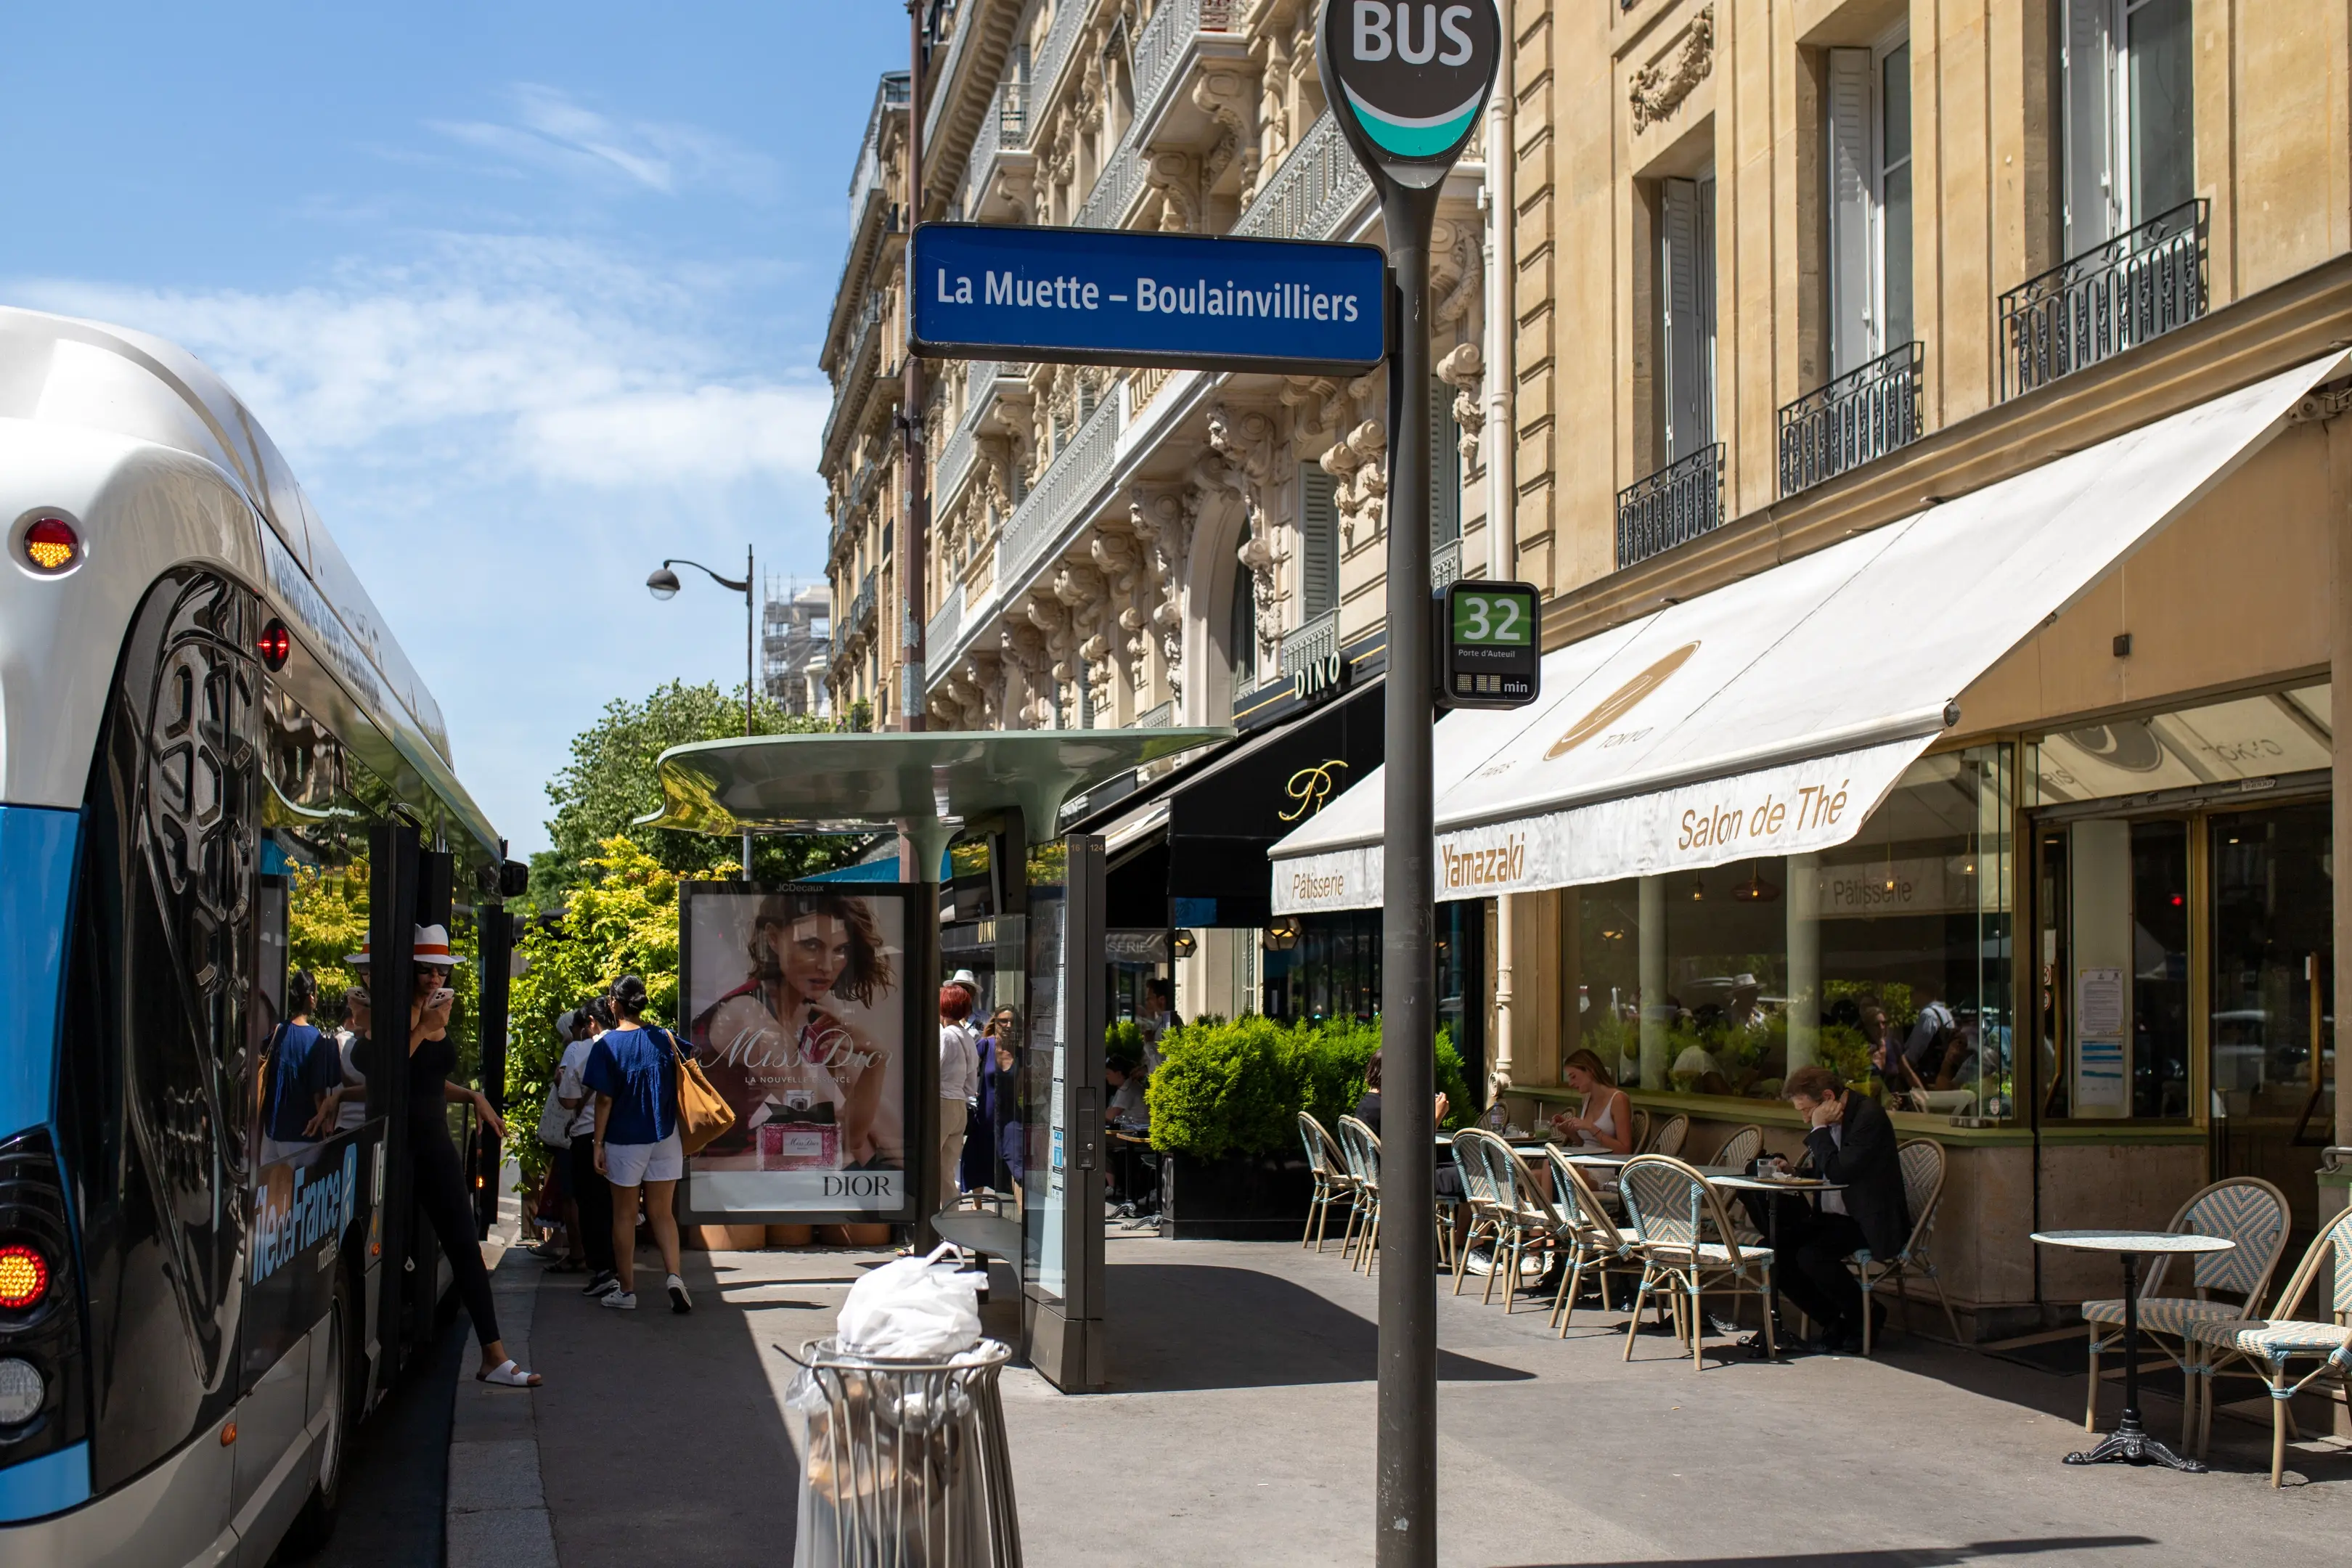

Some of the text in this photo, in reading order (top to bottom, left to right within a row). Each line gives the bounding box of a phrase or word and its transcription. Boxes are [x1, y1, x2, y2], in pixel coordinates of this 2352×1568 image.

[1354, 0, 1473, 66] BUS
[938, 268, 973, 305] La
[984, 271, 1099, 310] Muette
[1137, 278, 1359, 322] Boulainvilliers
[1463, 597, 1520, 640] 32
[1295, 650, 1341, 701] DINO
[1504, 681, 1528, 693] min
[1678, 779, 1850, 851] Salon de Thé
[1071, 844, 1104, 852] 16 124
[1442, 832, 1524, 889] Yamazaki
[776, 883, 824, 892] JCDecaux
[1292, 868, 1344, 899] Pâtisserie
[698, 1026, 893, 1069] Miss Dior
[822, 1175, 892, 1198] DIOR
